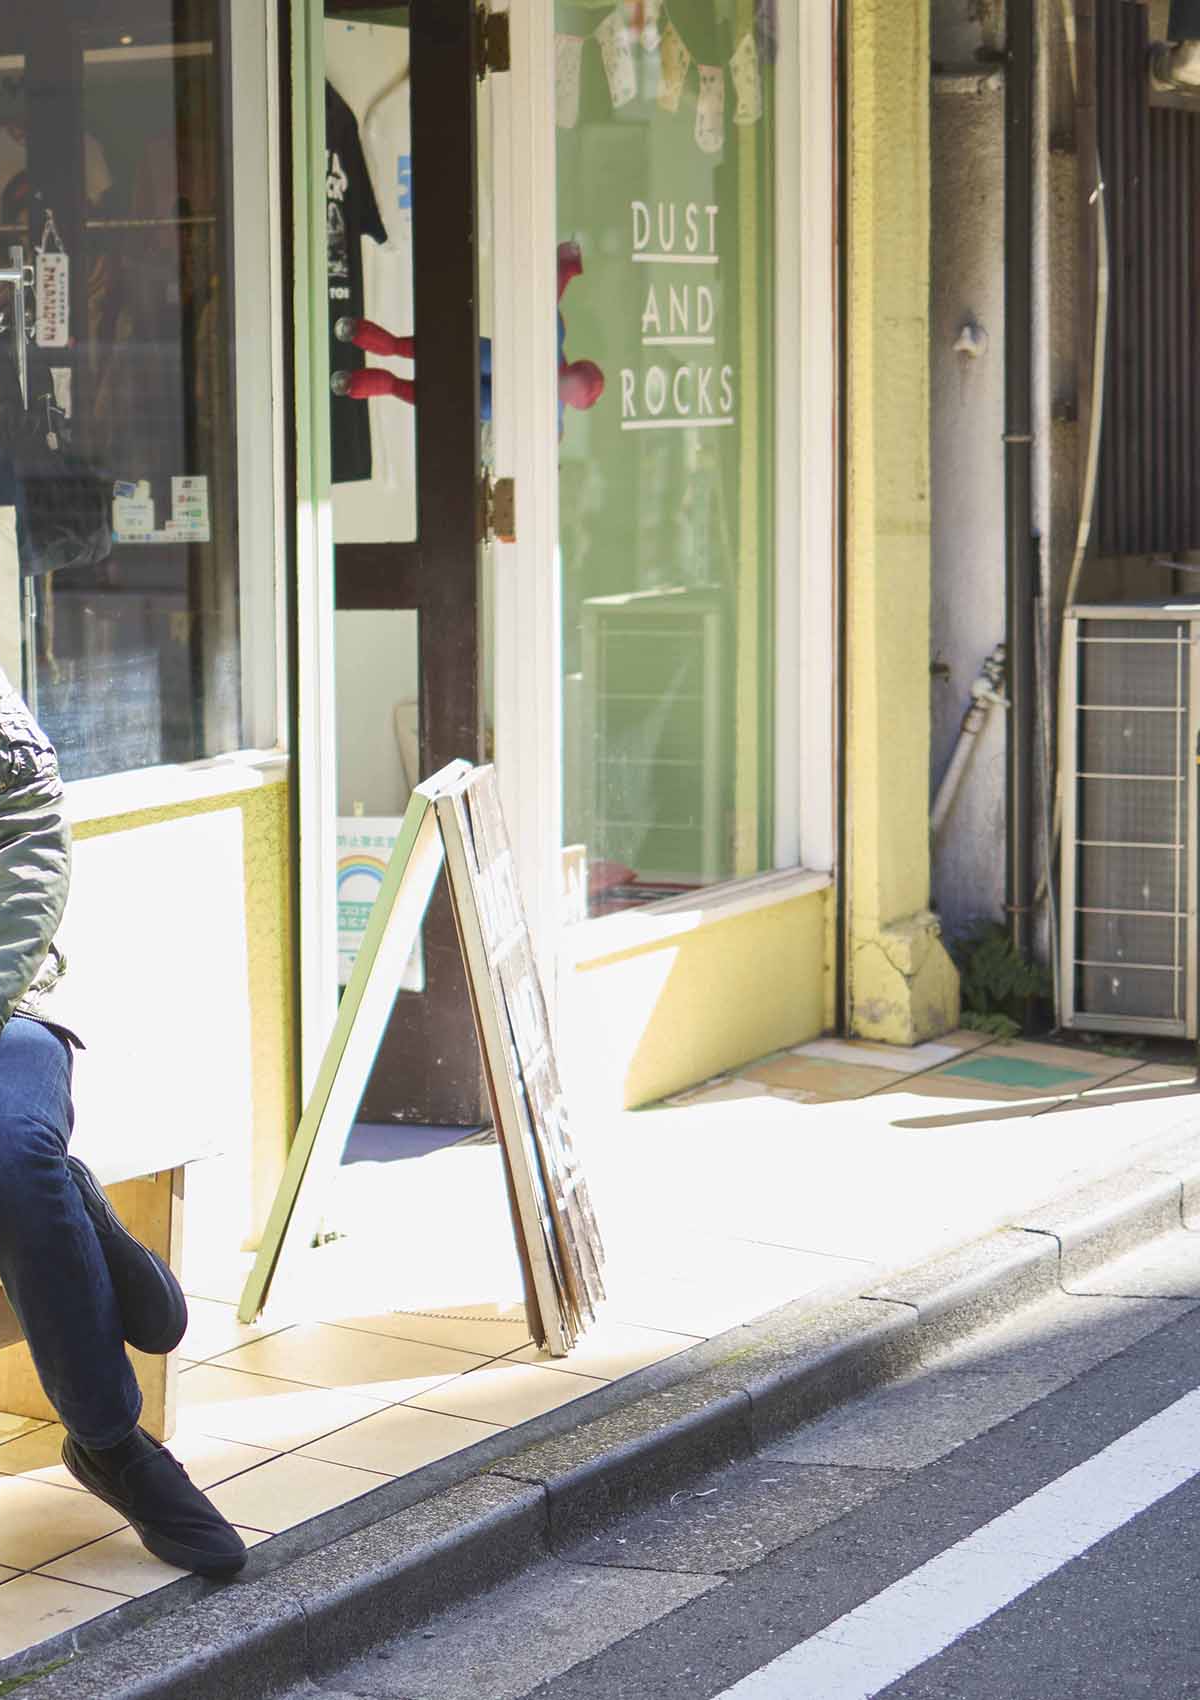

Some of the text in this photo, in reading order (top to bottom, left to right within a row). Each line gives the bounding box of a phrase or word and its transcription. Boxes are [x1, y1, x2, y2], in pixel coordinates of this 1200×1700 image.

[632, 201, 718, 252] DUST
[642, 284, 714, 333] AND
[620, 364, 733, 417] ROCKS
